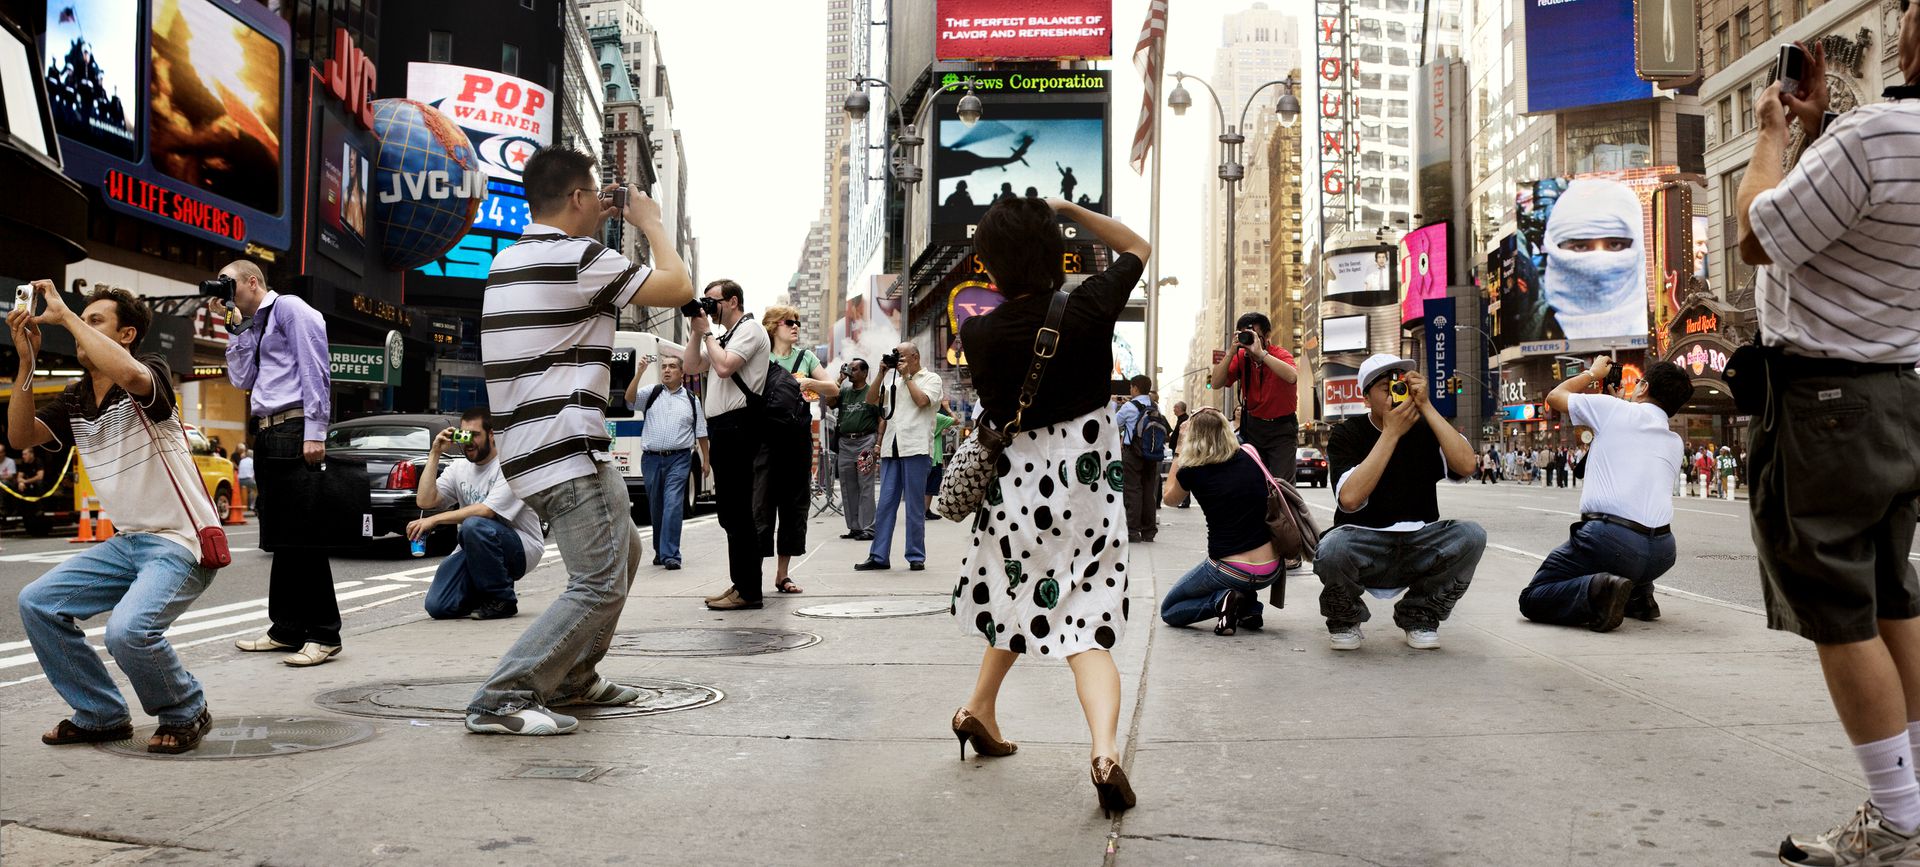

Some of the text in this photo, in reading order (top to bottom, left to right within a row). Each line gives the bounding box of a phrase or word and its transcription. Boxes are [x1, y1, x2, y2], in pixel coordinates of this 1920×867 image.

[945, 15, 1103, 28] THE PERFECT BALANCE OF
[942, 28, 1106, 40] FLAVOR AND REFRESHMENT
[323, 27, 377, 130] JVC
[1009, 73, 1104, 93] Corporation
[457, 74, 545, 116] POP
[1433, 64, 1445, 139] REPLAY
[454, 105, 540, 135] WARNER
[379, 170, 450, 204] JVC
[127, 176, 169, 217] LIFE
[173, 193, 230, 237] SAVERS
[1686, 313, 1717, 334] Hard Rock
[328, 352, 384, 365] ARBUCKS
[1521, 343, 1560, 353] REUTERS
[330, 363, 370, 375] OFFEE
[1436, 332, 1445, 399] REUTERS
[1326, 383, 1364, 401] CHUC
